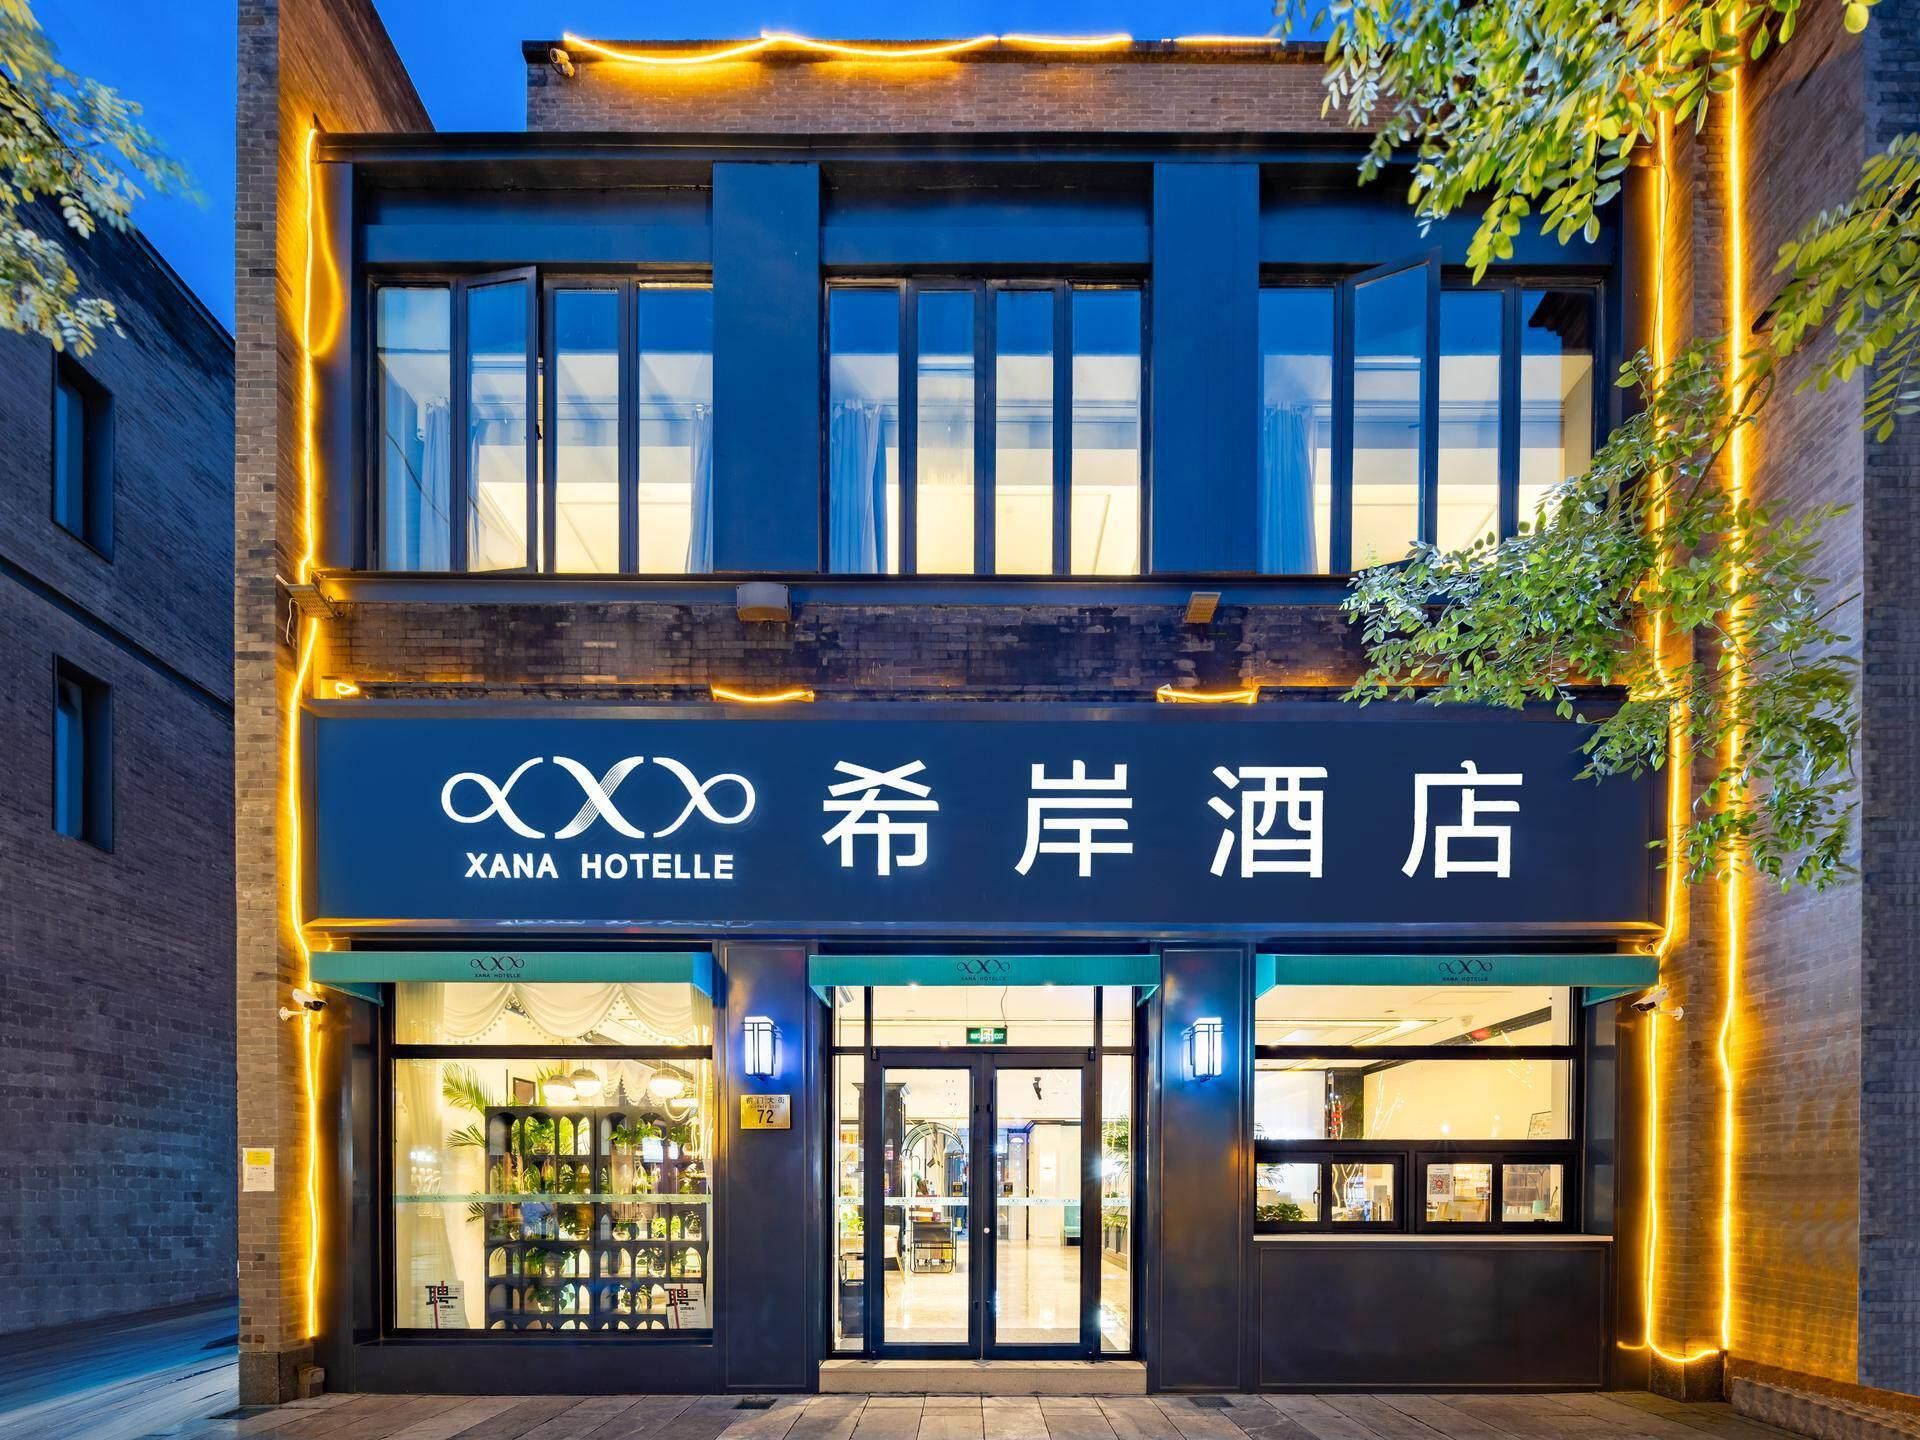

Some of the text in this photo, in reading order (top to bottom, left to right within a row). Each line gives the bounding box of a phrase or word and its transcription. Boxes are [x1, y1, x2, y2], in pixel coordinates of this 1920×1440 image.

[822, 759, 1524, 879] 希岸酒店
[464, 852, 734, 880] XANA HOTELLE
[757, 1109, 774, 1124] 72
[425, 1281, 458, 1306] 聘
[664, 1283, 698, 1307] 聘
